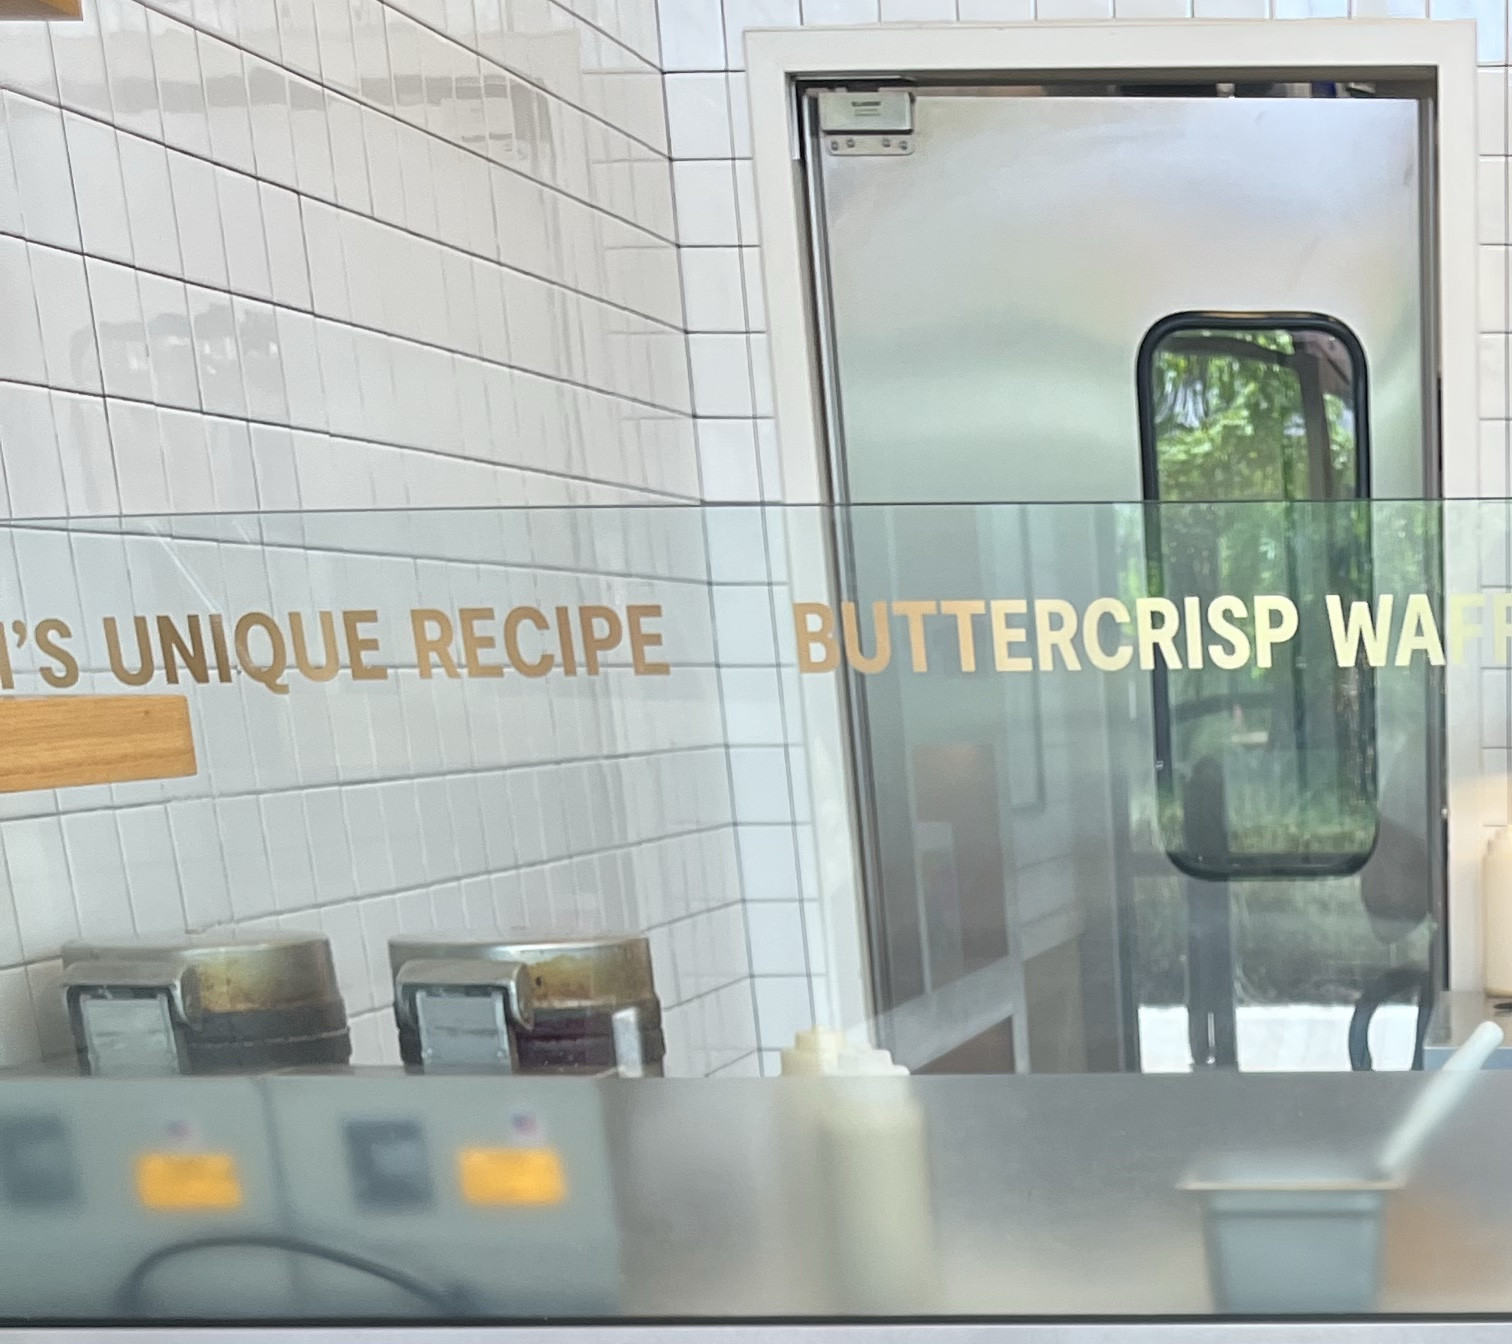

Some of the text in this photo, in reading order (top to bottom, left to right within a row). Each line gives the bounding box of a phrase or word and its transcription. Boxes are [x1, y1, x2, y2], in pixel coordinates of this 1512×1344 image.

[104, 609, 390, 695] UNIQUE
[410, 603, 671, 680] RECIPE
[793, 594, 1299, 674] BUTTERCRISP
